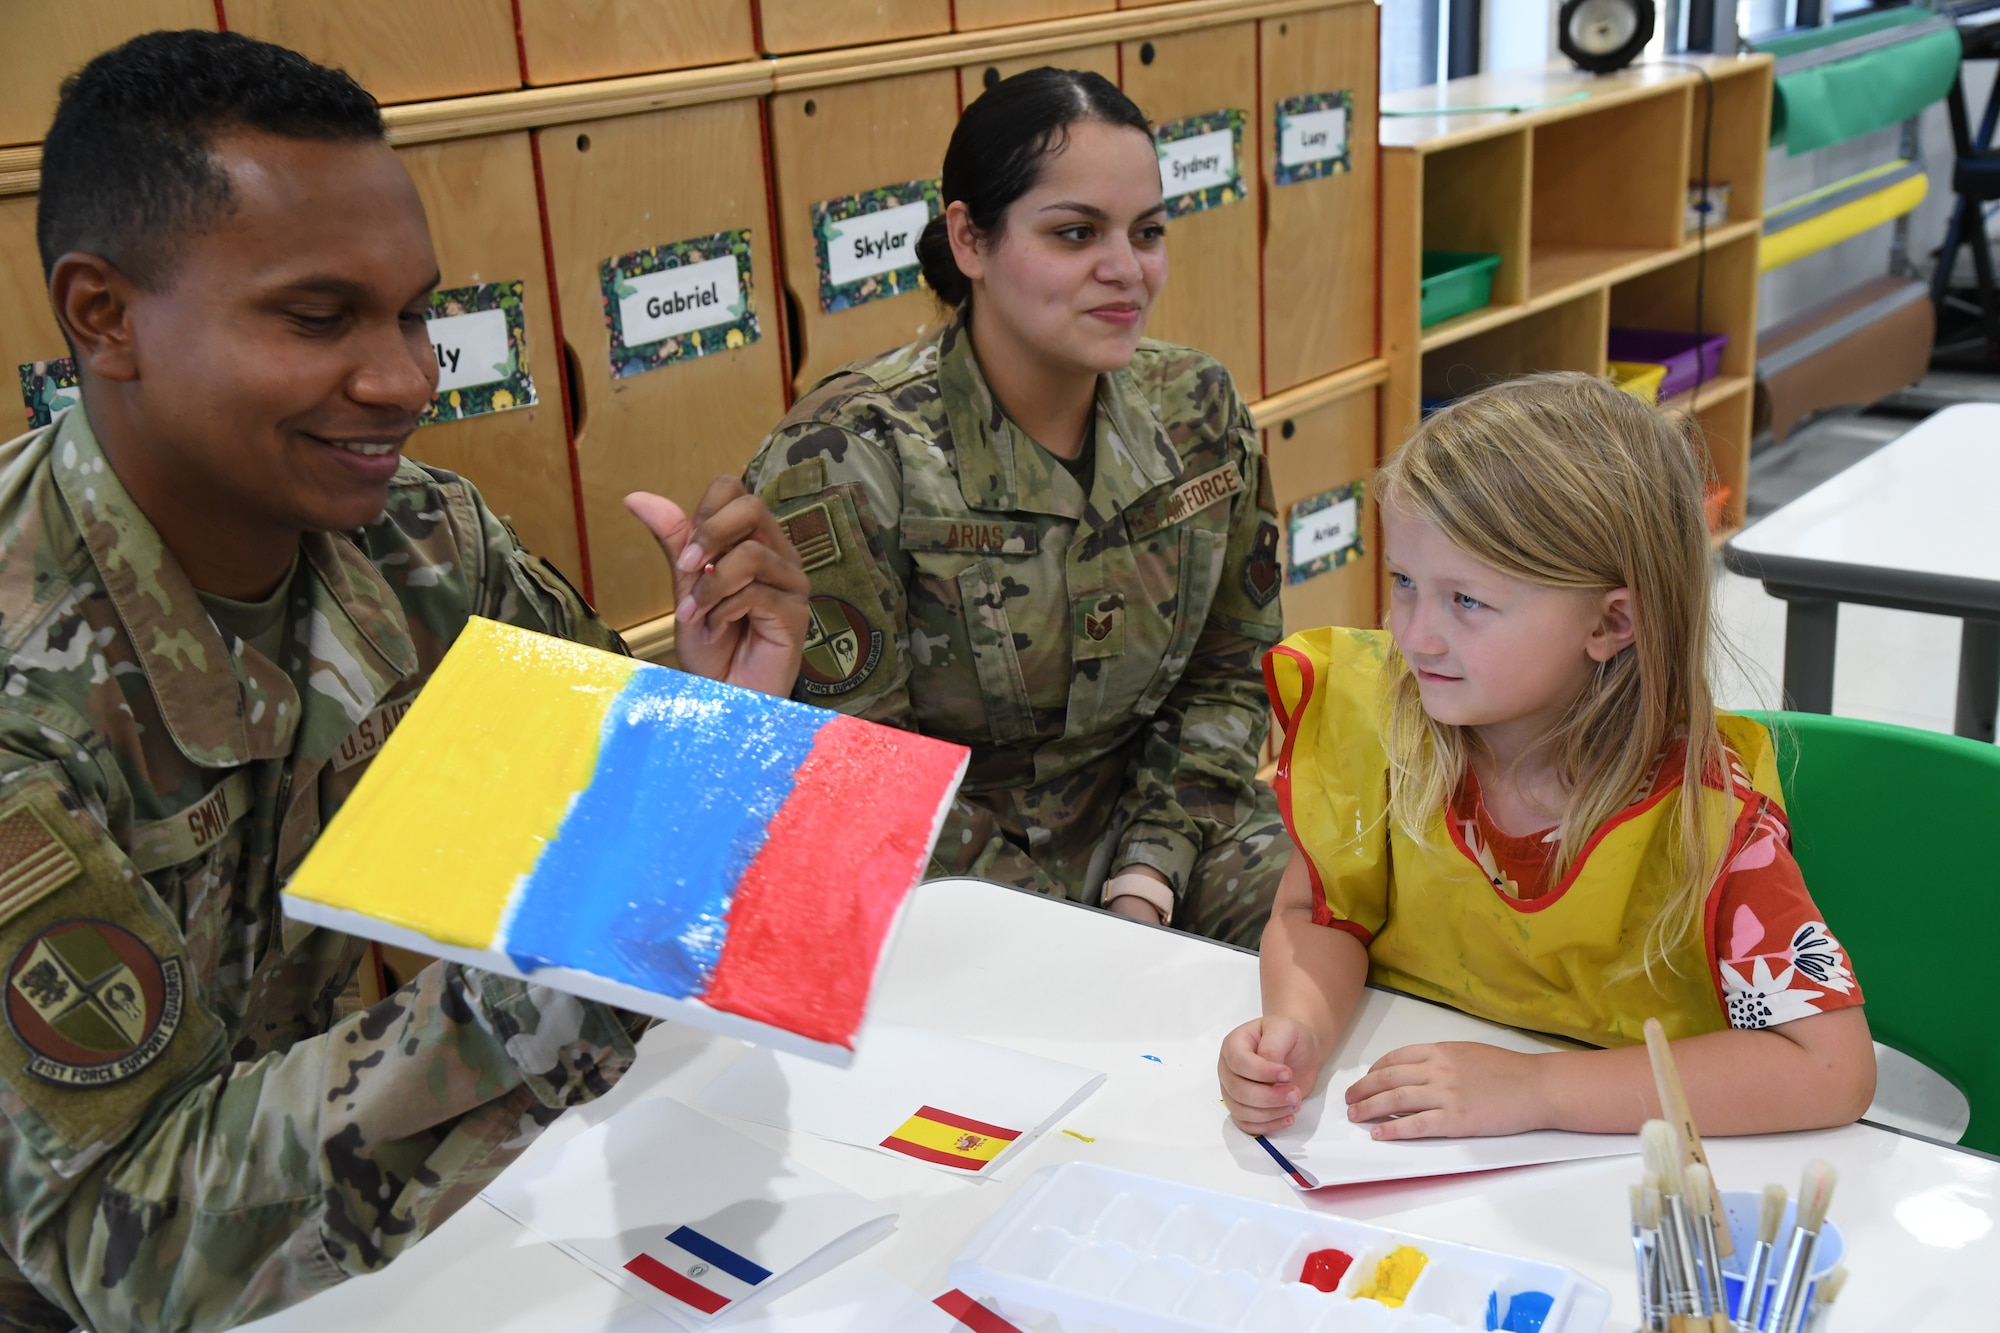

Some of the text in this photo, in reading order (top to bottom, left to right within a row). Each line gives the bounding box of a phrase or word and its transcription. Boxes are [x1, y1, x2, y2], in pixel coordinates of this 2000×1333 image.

[1301, 130, 1328, 148] Lucy
[1172, 154, 1219, 180] Sydney
[854, 230, 908, 259] Skylar
[646, 281, 719, 319] Gabriel
[1164, 494, 1188, 523] AIR
[1182, 468, 1238, 511] FORCE
[945, 523, 1005, 549] ARIAS
[806, 682, 830, 695] FORCE
[833, 672, 866, 694] SUPPORT
[71, 1066, 117, 1083] FORCE
[120, 1029, 169, 1074] SUPPORT
[162, 961, 181, 1029] SQUADRON
